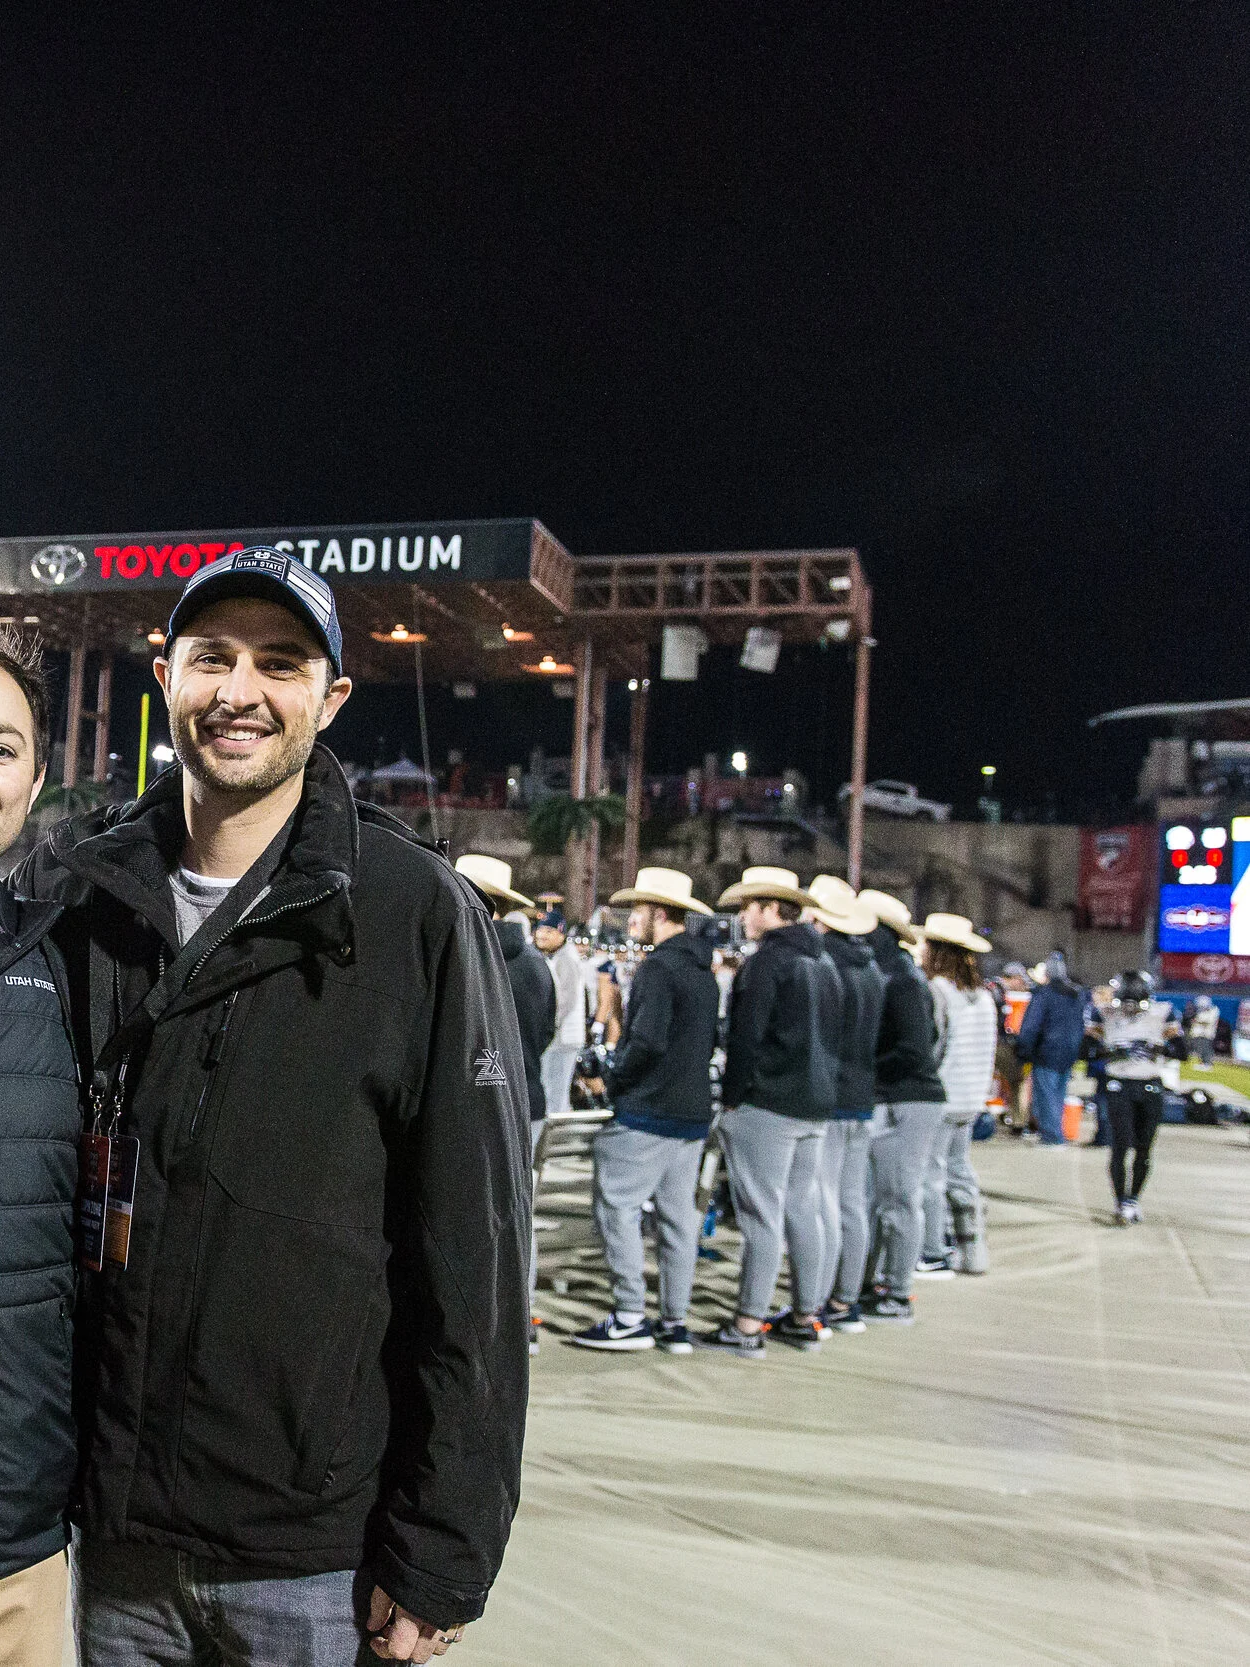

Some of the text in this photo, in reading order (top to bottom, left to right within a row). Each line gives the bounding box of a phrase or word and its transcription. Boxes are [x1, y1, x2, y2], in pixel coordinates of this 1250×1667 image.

[260, 562, 283, 571] STATE
[5, 976, 56, 993] UTAH STATE
